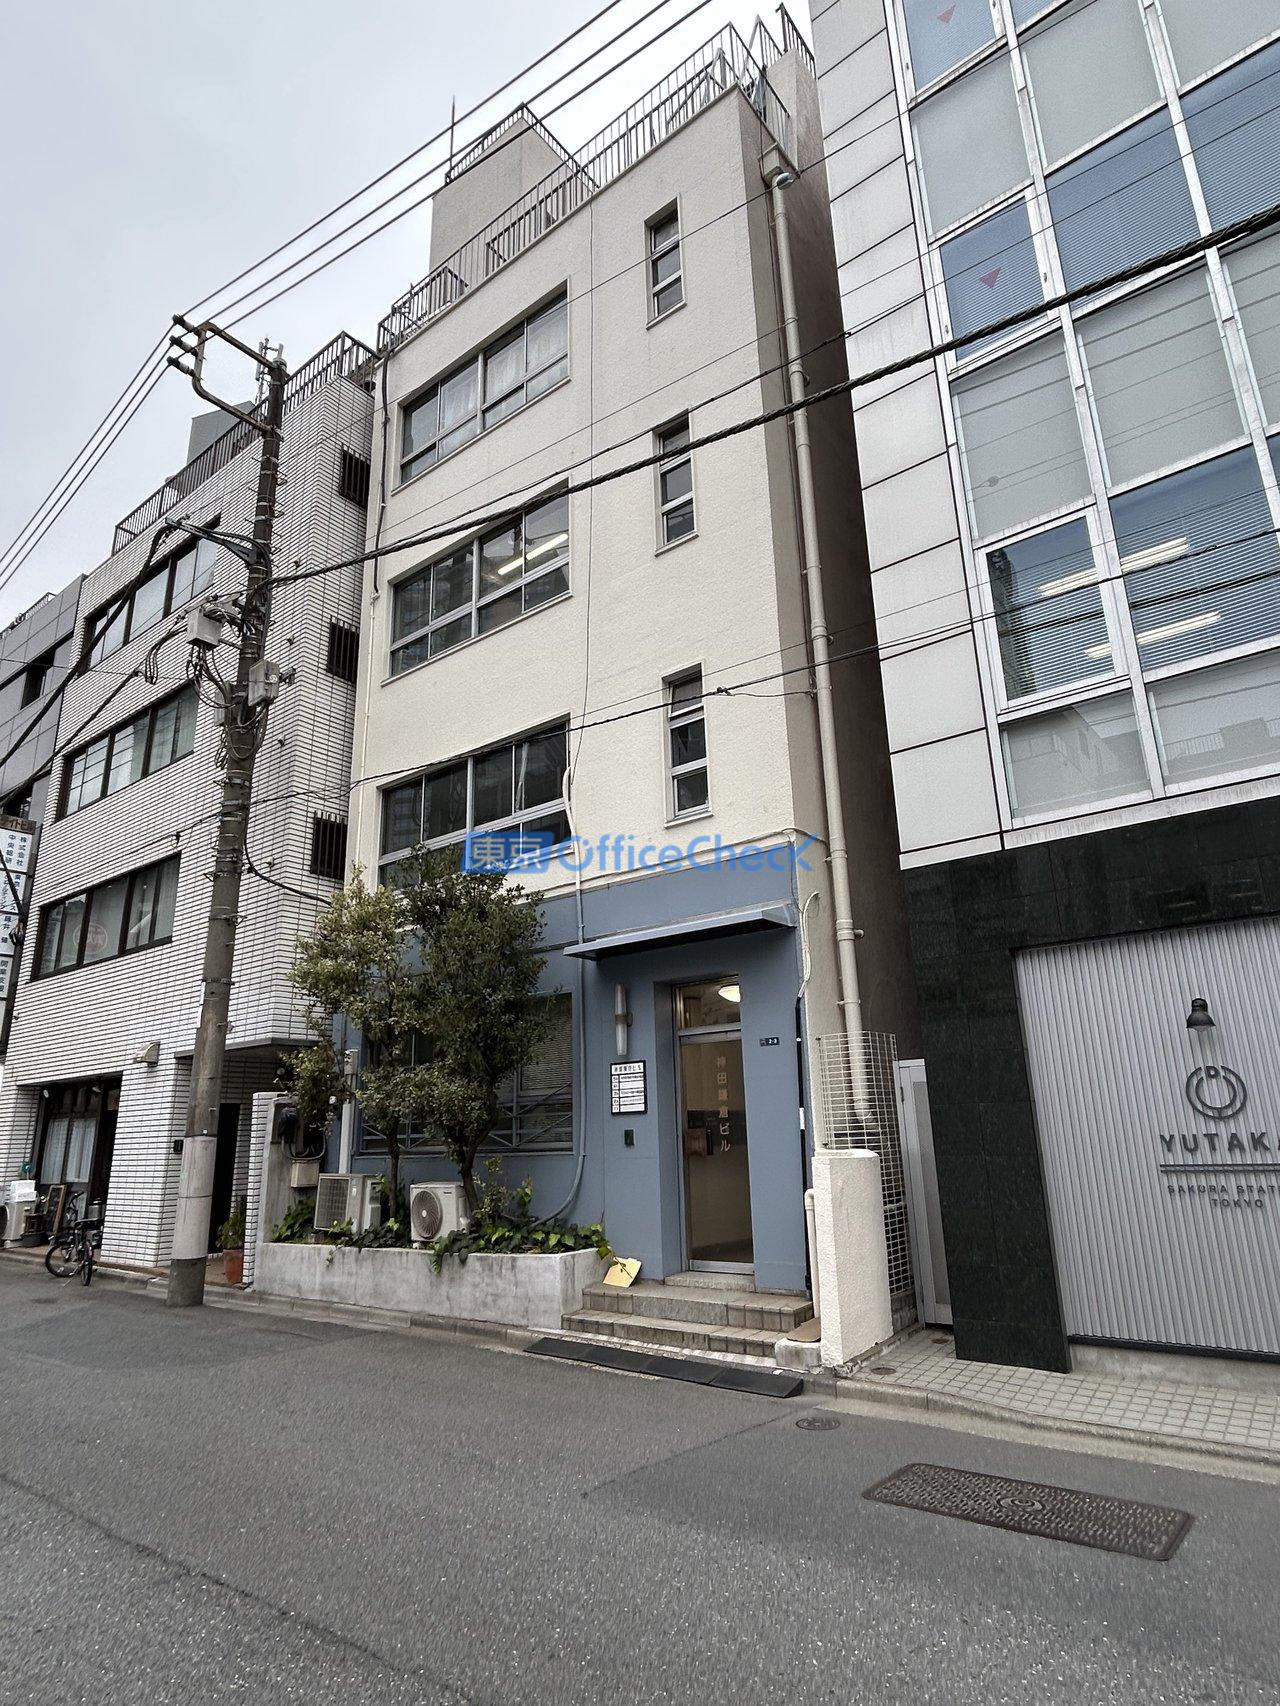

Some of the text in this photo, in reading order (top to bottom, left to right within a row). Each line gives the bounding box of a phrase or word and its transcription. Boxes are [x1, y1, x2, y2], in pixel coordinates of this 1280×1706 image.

[16, 836, 27, 867] 株式会社
[1160, 1132, 1280, 1153] YUTAK
[1211, 1198, 1264, 1208] TOKYO
